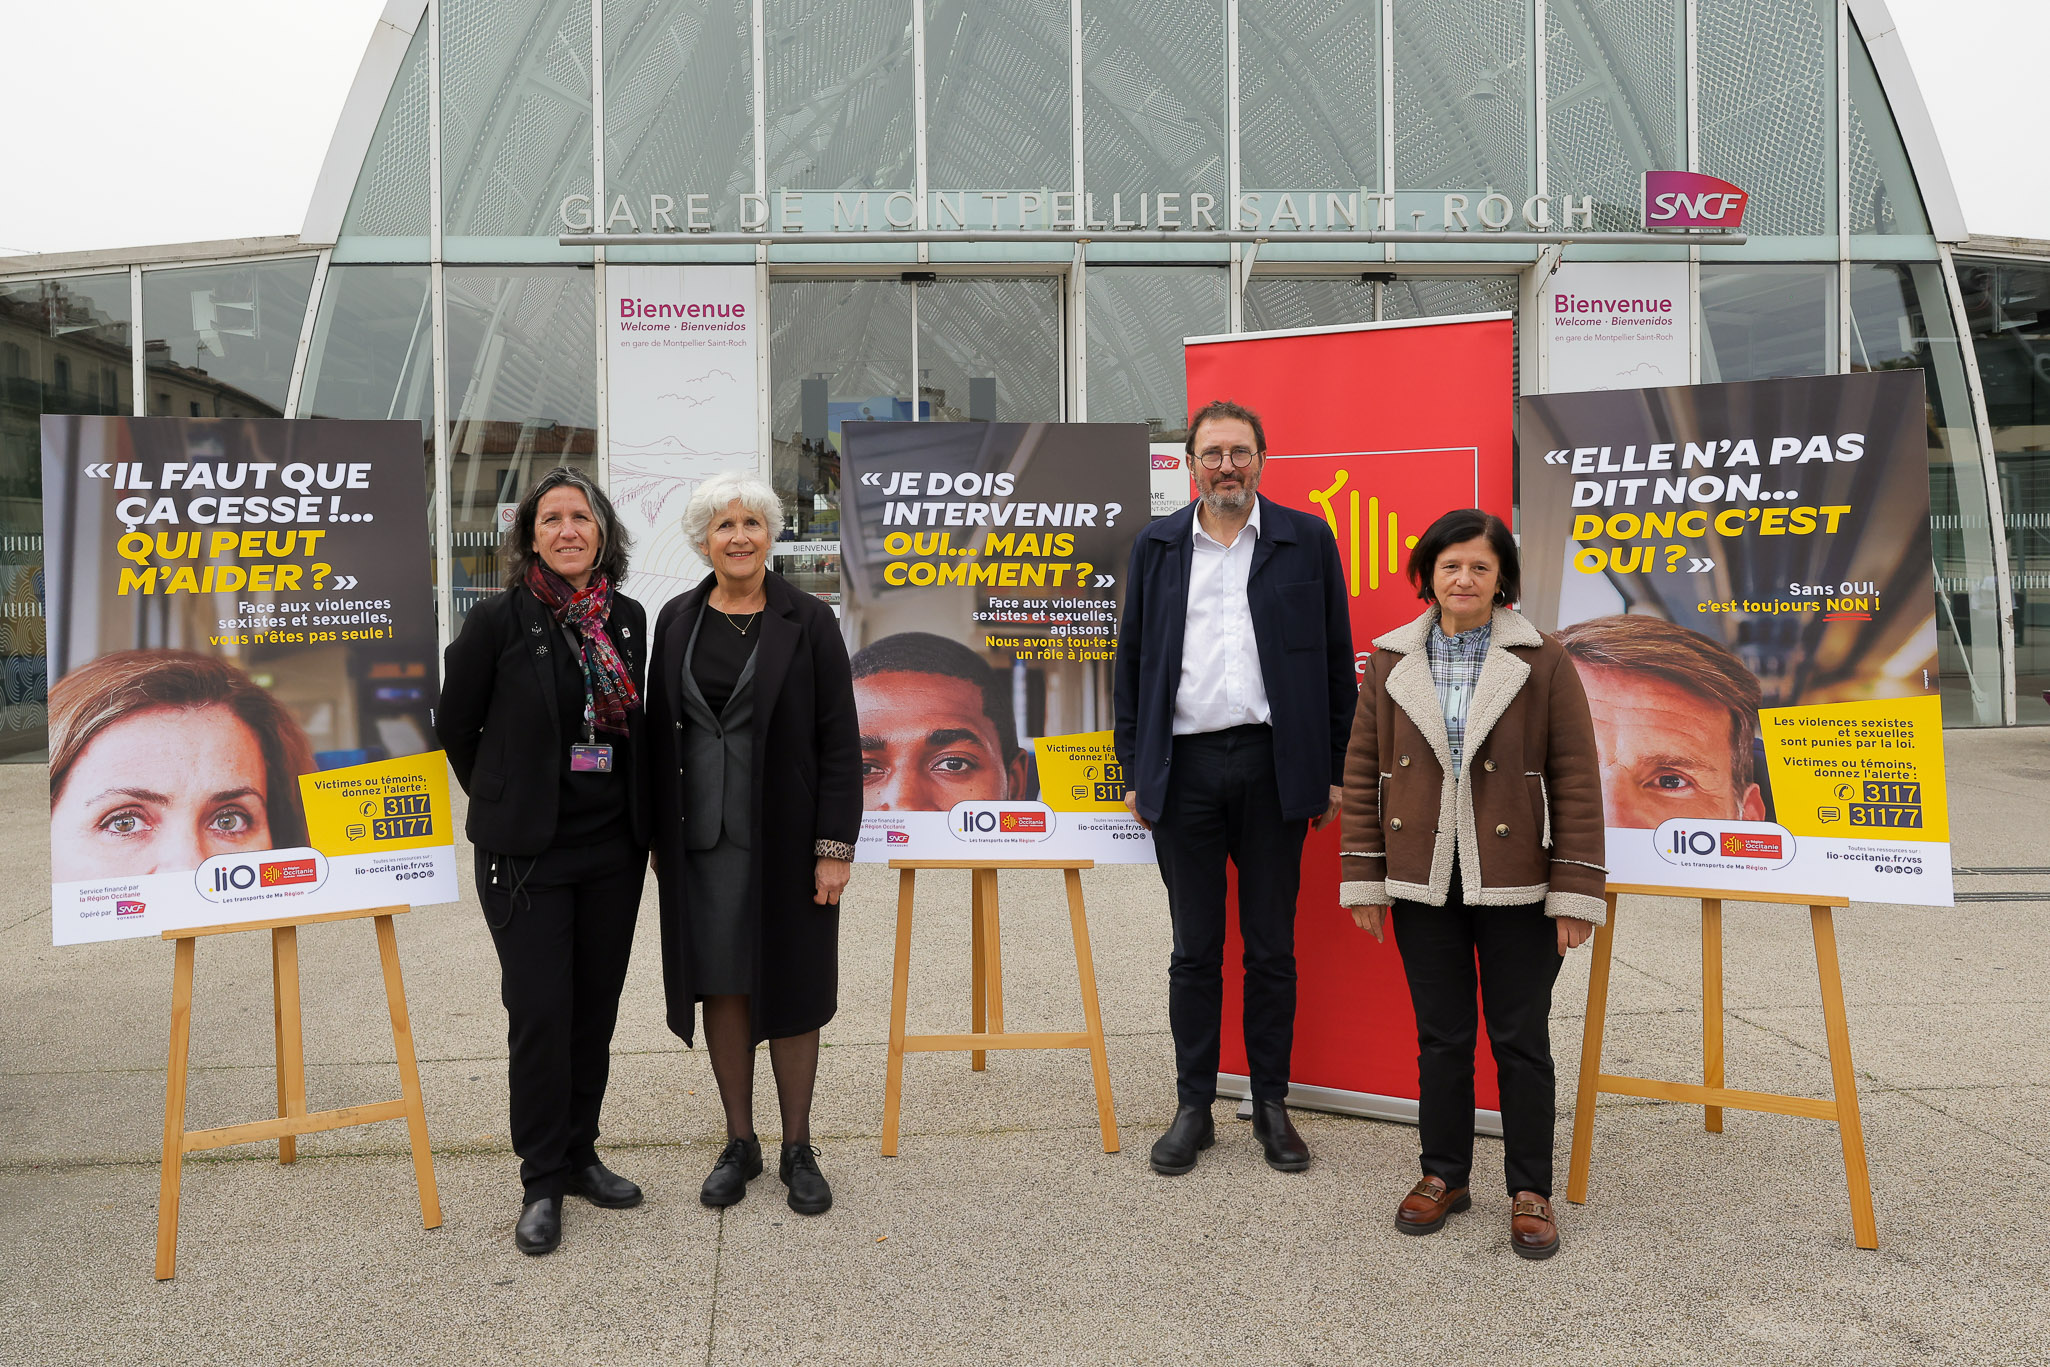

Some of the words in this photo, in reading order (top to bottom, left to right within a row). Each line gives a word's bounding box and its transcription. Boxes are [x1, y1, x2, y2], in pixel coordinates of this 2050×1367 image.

[559, 193, 711, 230] GARE
[739, 193, 804, 229] DE
[833, 192, 1217, 230] MONTPELLIER
[1650, 192, 1743, 221] SNCF
[620, 298, 746, 318] Bienvenue
[1554, 294, 1672, 313] Bienvenue
[620, 321, 671, 331] Welcome
[680, 321, 746, 331] Bienvenidos
[1555, 317, 1602, 326] Welcome
[1611, 316, 1673, 326] Bienvenidos
[632, 341, 650, 349] gare
[651, 339, 661, 347] de
[663, 339, 705, 349] Montpellier
[707, 339, 747, 347] Saint-Roch
[1566, 335, 1582, 343] gare
[1583, 333, 1593, 341] de
[1594, 333, 1635, 342] Montpellier
[1636, 333, 1674, 341] Saint-Roch
[1681, 439, 1760, 470] N'A
[1768, 433, 1865, 466] PAS
[1152, 459, 1178, 469] SNCF
[160, 463, 277, 490] FAUT
[280, 463, 372, 495] QUE
[926, 472, 1015, 497] DOIS
[1571, 479, 1648, 508] DIT
[1652, 473, 1799, 505] NON...
[115, 497, 180, 533] ÇA
[187, 496, 324, 525] CESSE
[882, 502, 1099, 527] INTERVENIR
[1571, 508, 1708, 541] DONC
[1713, 504, 1851, 537] C'EST
[116, 531, 202, 566] QUI
[209, 530, 326, 558] PEUT
[793, 544, 837, 552] BIENVENUE
[882, 532, 978, 557] OUI...
[984, 532, 1075, 557] MAIS
[1573, 545, 1655, 574] OUI
[883, 562, 1072, 587] COMMENT
[1789, 582, 1834, 596] Sans
[1839, 580, 1880, 598] OUI,
[238, 601, 276, 614] Face
[280, 602, 312, 613] aux
[315, 599, 391, 612] violences
[989, 596, 1019, 609] Face
[1022, 599, 1048, 609] aux
[1052, 597, 1117, 609] violences
[1697, 600, 1738, 613] c'est
[1742, 598, 1821, 616] toujours
[1826, 597, 1869, 612] NON
[218, 615, 288, 629] sexistes
[290, 614, 308, 626] et
[312, 611, 393, 626] sexuelles,
[972, 609, 1028, 621] sexistes
[1031, 611, 1046, 621] et
[1049, 610, 1118, 623] sexuelles,
[208, 634, 249, 646] vous
[253, 630, 304, 644] n'êtes
[308, 631, 337, 645] pas
[341, 627, 384, 641] seule
[1050, 623, 1109, 637] agissons
[985, 635, 1020, 647] Nous
[1023, 639, 1063, 647] avons
[1016, 651, 1033, 660] un
[1037, 648, 1064, 660] rôle
[1067, 648, 1076, 660] à
[1773, 716, 1795, 726] Les
[1798, 716, 1858, 727] violences
[1861, 717, 1914, 728] sexistes
[1838, 728, 1851, 738] et
[1854, 728, 1914, 738] sexuelles
[1046, 744, 1087, 752] Victimes
[1780, 737, 1808, 747] sont
[1811, 738, 1854, 750] punies
[1856, 739, 1878, 750] par
[1881, 738, 1892, 749] la
[1896, 738, 1915, 749] loi.
[1069, 753, 1102, 761] donnez
[1783, 757, 1838, 768] Victimes
[1841, 760, 1857, 769] ou
[1860, 758, 1917, 770] témoins,
[1814, 768, 1860, 779] donnez
[1864, 769, 1909, 780] l'alerte
[314, 779, 362, 790] Victimes
[364, 778, 378, 786] ou
[381, 773, 427, 785] témoins,
[342, 787, 381, 798] donnez
[384, 782, 421, 794] l'alerte
[1865, 783, 1918, 803] 3117
[386, 795, 428, 815] 3117
[1852, 806, 1919, 827] 31177
[375, 817, 430, 838] 31177
[1826, 852, 1922, 864] lio-occitanie.fr/vss
[283, 868, 314, 876] Occitanie
[355, 861, 434, 875] lio-occitanie.fr/vss
[1745, 864, 1768, 872] Région
[104, 885, 128, 893] financé
[234, 894, 266, 902] transports
[79, 910, 100, 919] Opéré
[117, 904, 145, 914] SNCF
